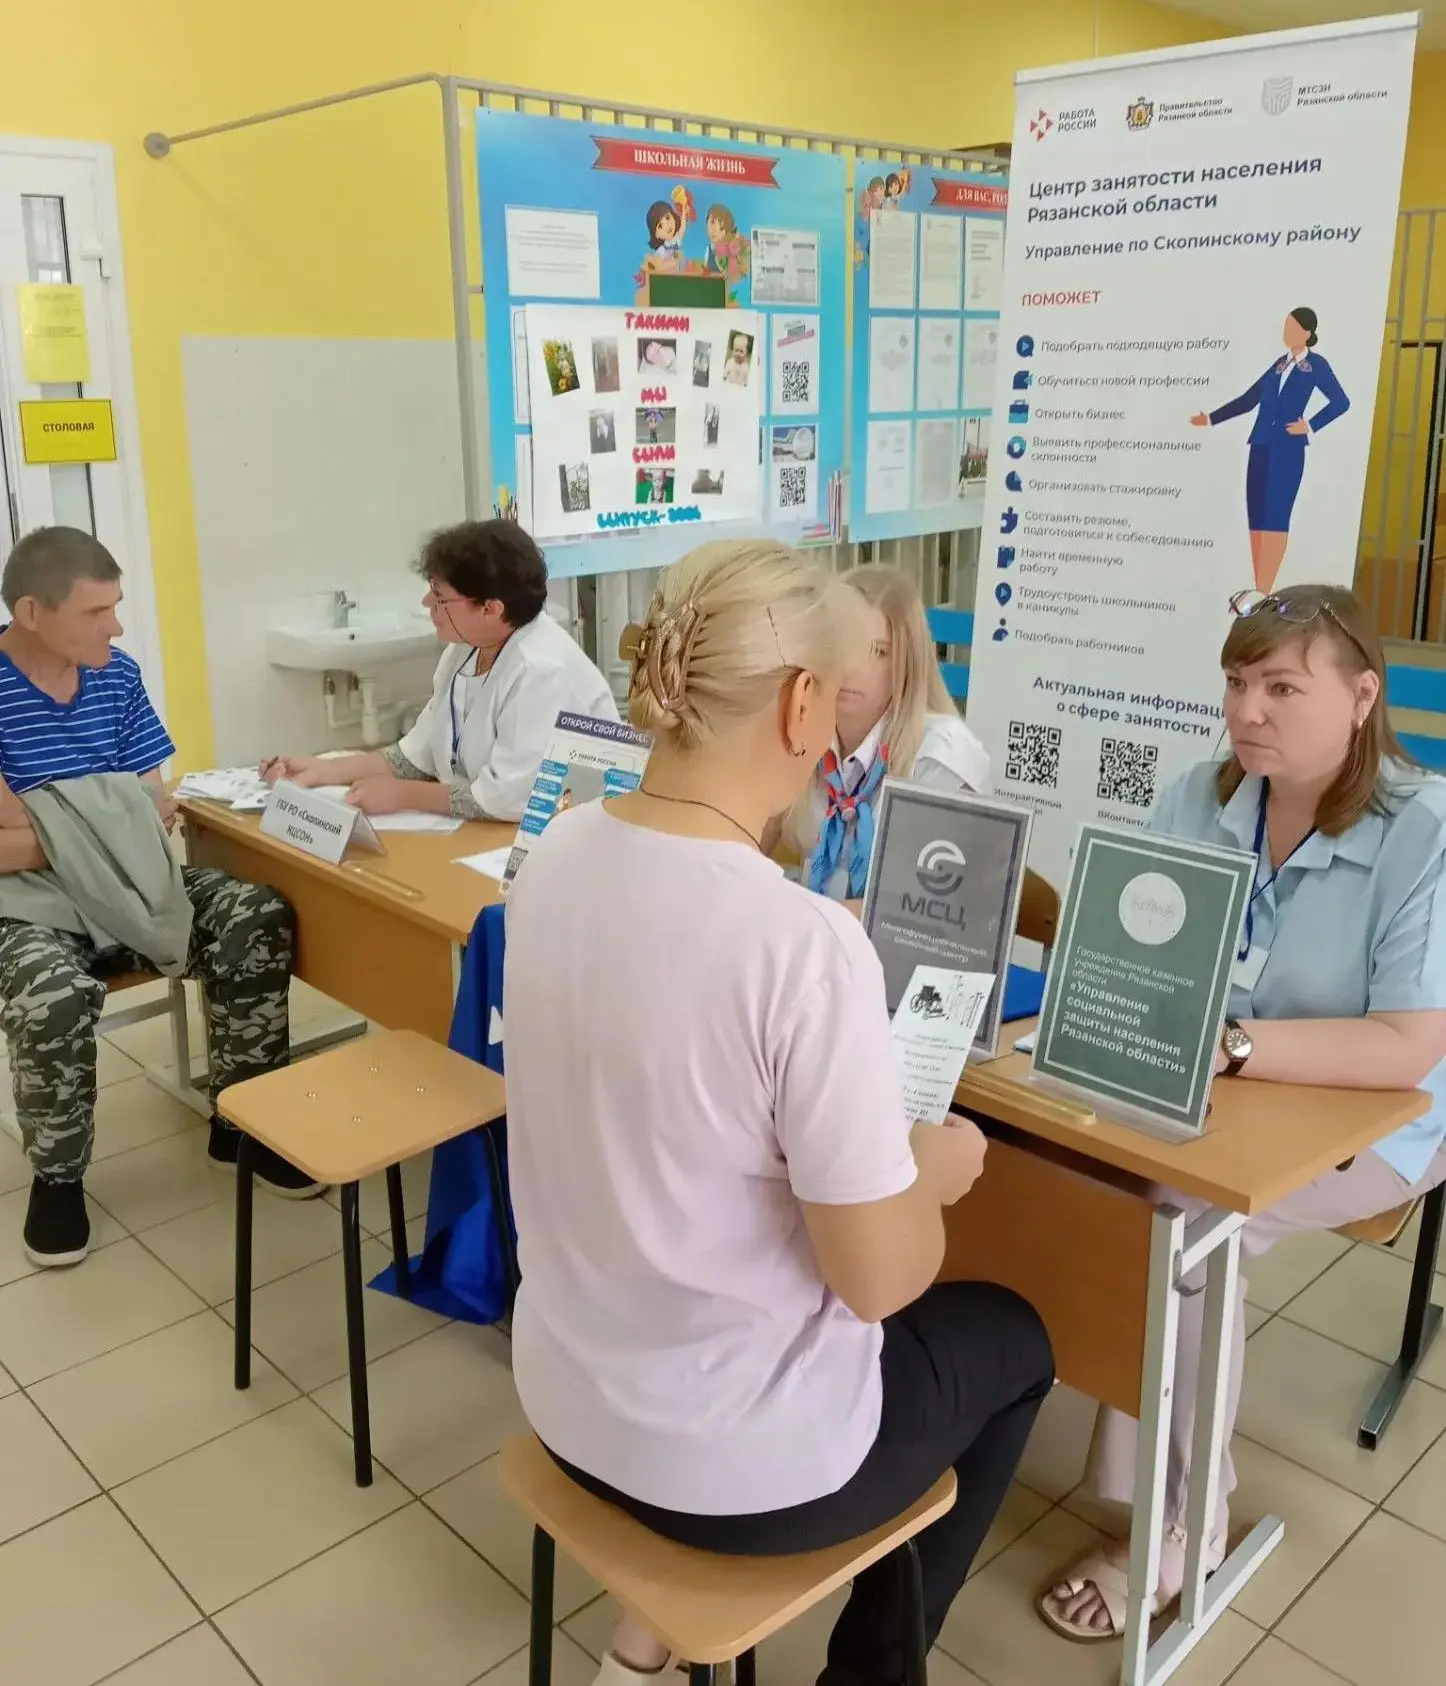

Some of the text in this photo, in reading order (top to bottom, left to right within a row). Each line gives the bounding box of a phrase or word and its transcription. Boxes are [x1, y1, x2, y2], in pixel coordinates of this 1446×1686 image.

[1298, 83, 1331, 95] МТСЗН
[1159, 98, 1224, 112] Правительство
[1297, 90, 1388, 107] Рязанской области
[1058, 109, 1095, 121] РАБОТА
[1198, 107, 1233, 119] области
[1057, 119, 1097, 132] РОССИИ
[634, 148, 746, 175] ШКОЛЬНАЯ ЖИЗНЬ
[1029, 156, 1322, 200] Центр занятости населения
[955, 187, 973, 201] ДЛЯ
[1027, 192, 1218, 223] Рязанской области
[1025, 224, 1361, 261] Управление по Скопинскому району
[1022, 289, 1101, 307] ПОМОЖЕТ
[625, 312, 690, 333] ТАКИМИ
[1041, 337, 1230, 353] Подобрать подходящую работу
[1037, 374, 1210, 388] Обучиться новой профессии
[1034, 408, 1126, 420] Открыть бизнес
[42, 422, 95, 433] СТОЛОВАЯ
[1032, 436, 1202, 452] Выявить профессиональные
[1031, 453, 1097, 463] склонности
[1028, 479, 1182, 498] Организовать стажировку
[1024, 511, 1131, 528] Составить резюме,
[1023, 526, 1214, 548] подготовиться к собеседованию
[1021, 548, 1124, 567] Найти временную
[1019, 563, 1058, 576] работу
[1019, 586, 1176, 613] Трудоустроить школьников
[1017, 601, 1080, 617] в каникулы
[1015, 629, 1145, 655] Подобрать работников
[1033, 676, 1125, 702] Актуальная
[1056, 702, 1211, 737] о сфере занятости
[561, 716, 649, 744] ОТКРОЙ СВОЙ БИЗНЕС
[578, 753, 617, 767] РАБОТА РОССИИ
[276, 798, 290, 811] ГБУ
[288, 804, 299, 815] РО
[994, 787, 1062, 810] Интерактивный
[1098, 810, 1144, 827] ВКонтакт
[901, 892, 967, 932] МСЦ
[1076, 945, 1196, 988] Государственное казенное
[1072, 968, 1108, 985] области
[1074, 958, 1175, 995] учреждение Рязанской
[1070, 980, 1150, 1014] «Управление
[1066, 995, 1141, 1027] социальной
[1064, 1011, 1181, 1057] защиты населения
[1060, 1023, 1187, 1075] Рязанской области»
